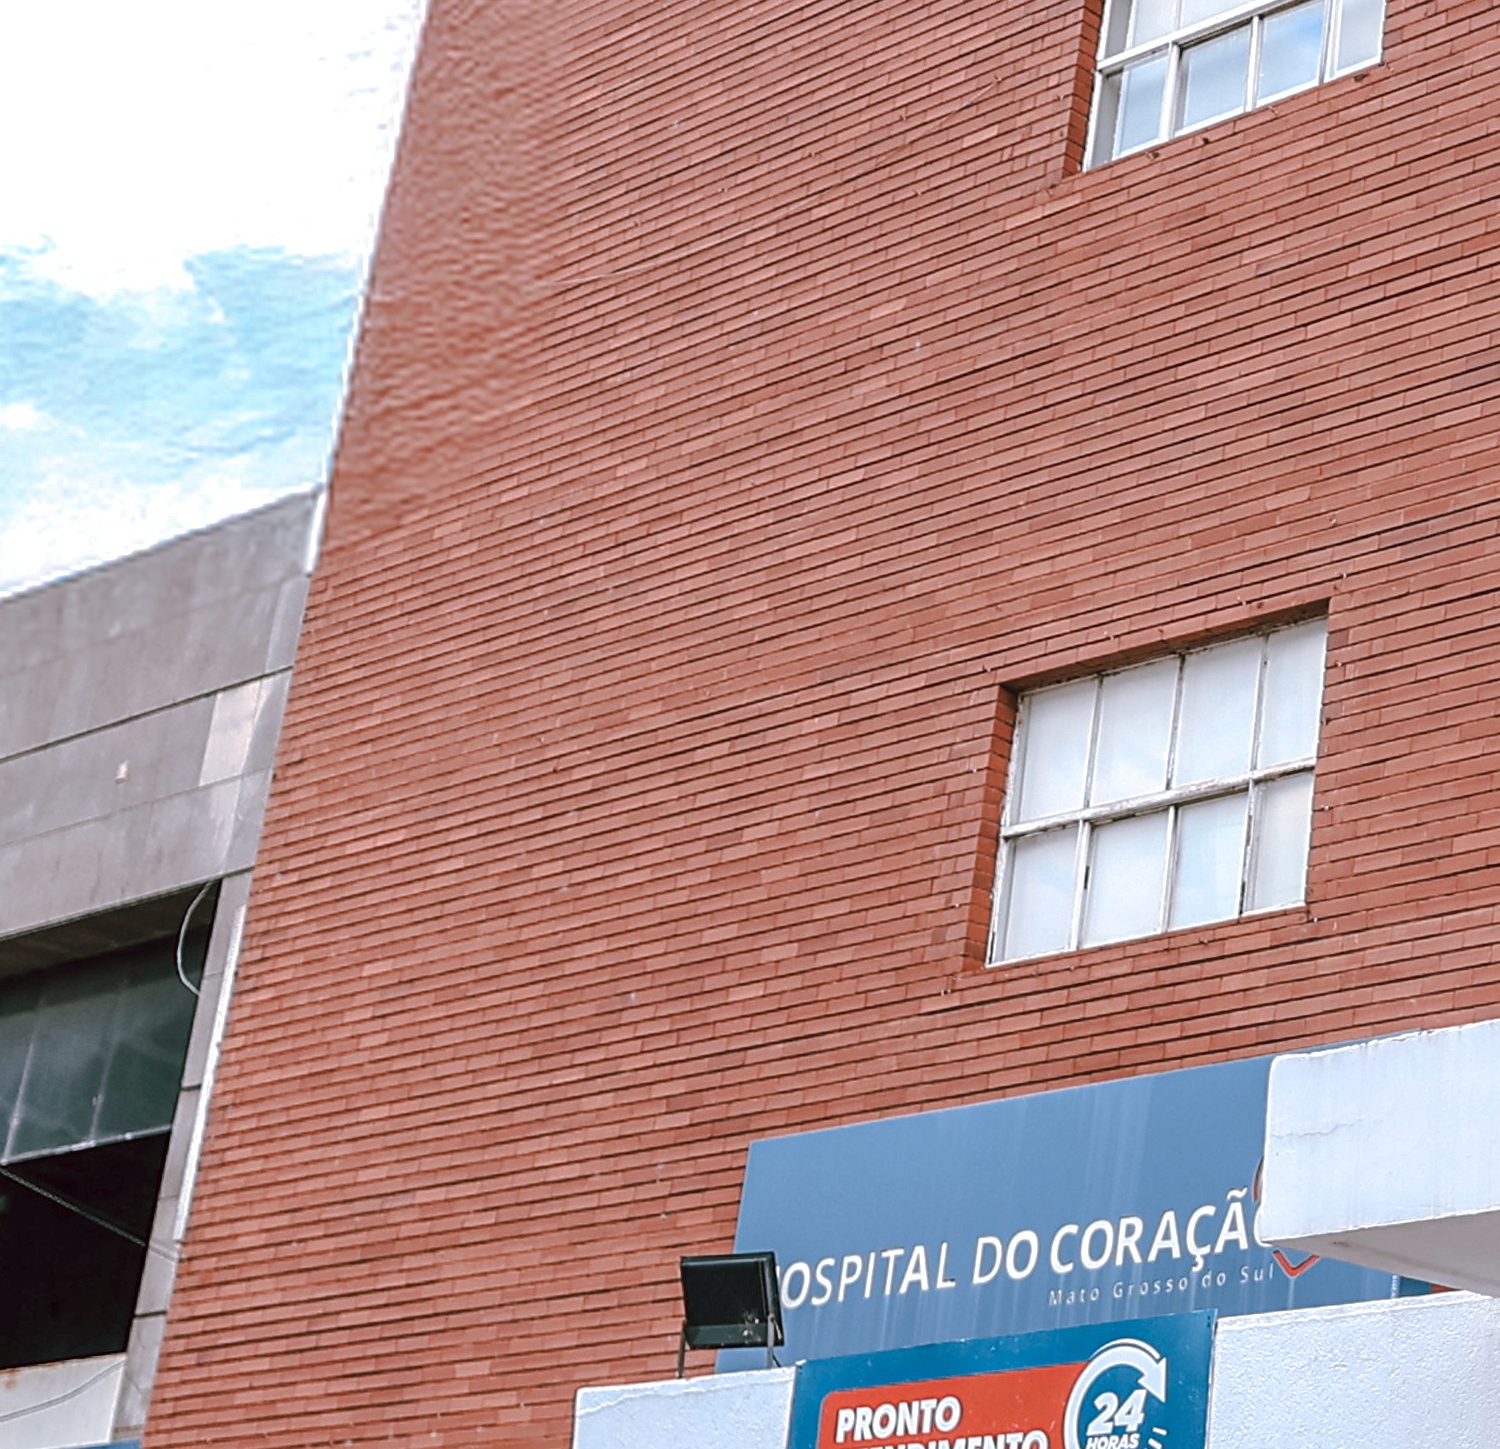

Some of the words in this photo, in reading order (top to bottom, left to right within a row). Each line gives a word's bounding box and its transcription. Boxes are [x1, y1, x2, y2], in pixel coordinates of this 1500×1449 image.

[776, 1241, 956, 1310] OSPITAL
[972, 1231, 1038, 1285] DO
[1049, 1288, 1100, 1306] Mato
[1112, 1276, 1189, 1298] Grosso
[1202, 1270, 1226, 1288] do
[1240, 1262, 1274, 1284] Sul
[835, 1396, 963, 1444] PRONTO
[1085, 1389, 1148, 1437] 24
